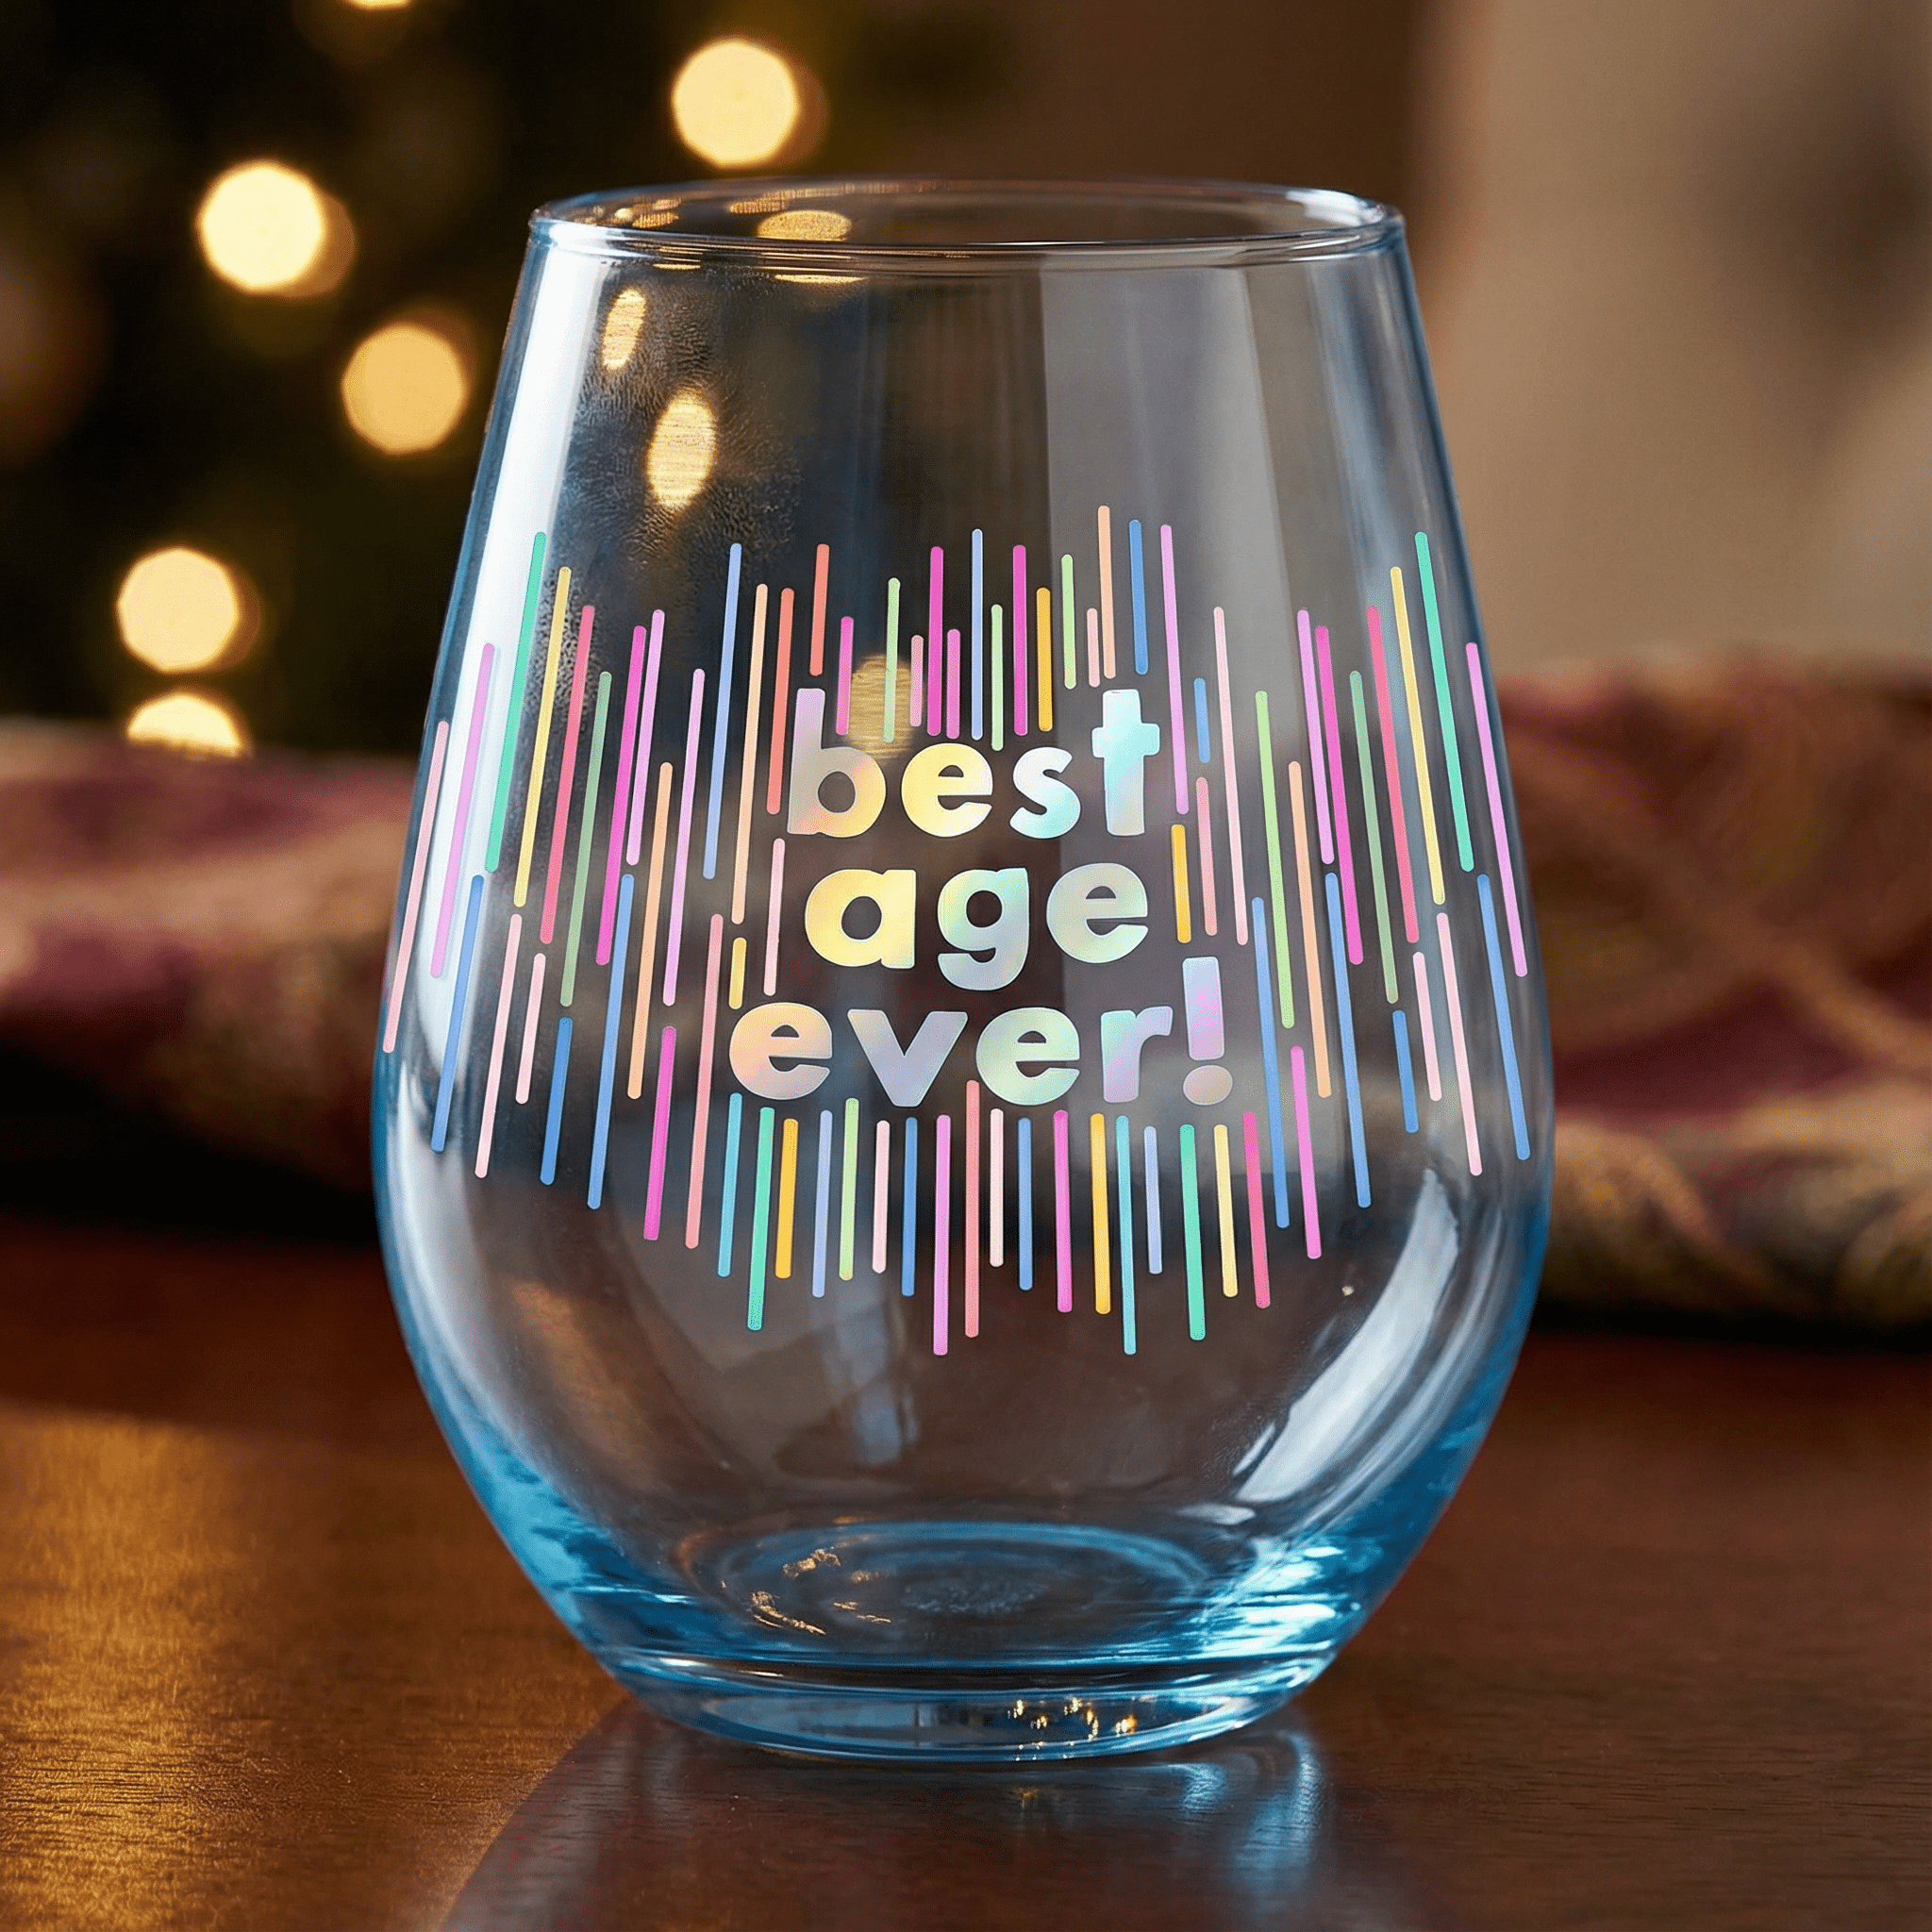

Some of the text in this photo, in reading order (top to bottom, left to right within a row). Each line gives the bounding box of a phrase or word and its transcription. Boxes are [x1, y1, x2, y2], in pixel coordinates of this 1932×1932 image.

[787, 688, 1160, 840] best
[804, 862, 1149, 991] age
[728, 956, 1234, 1108] ever!
